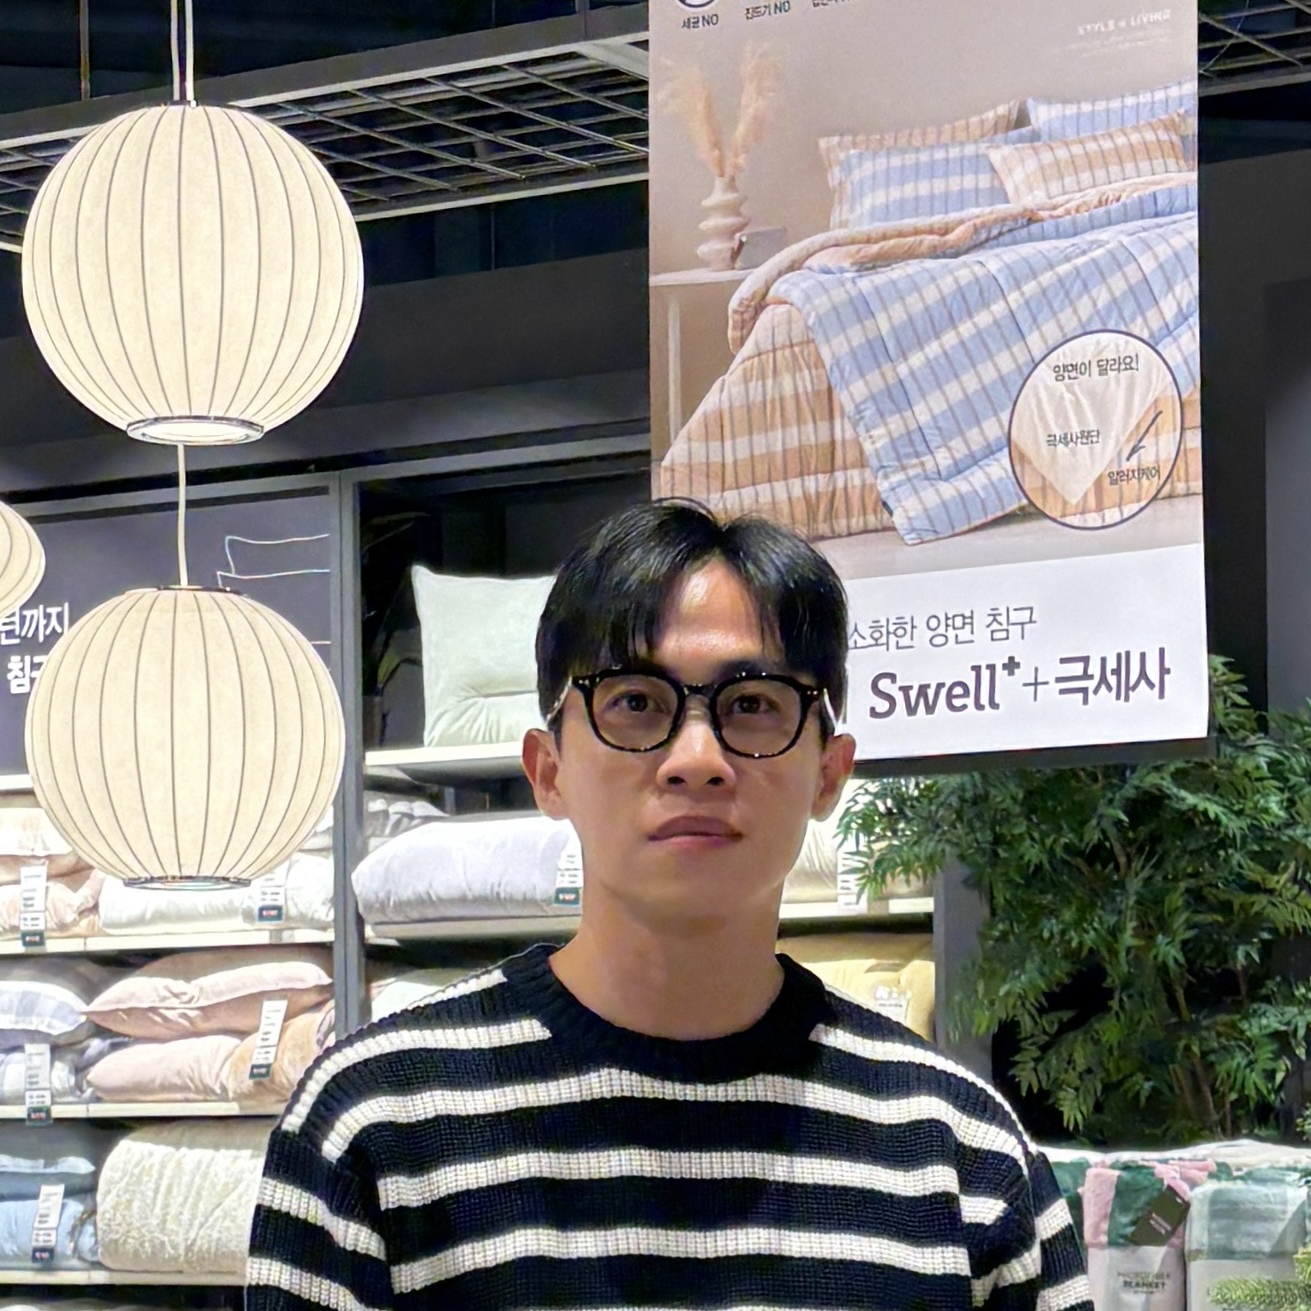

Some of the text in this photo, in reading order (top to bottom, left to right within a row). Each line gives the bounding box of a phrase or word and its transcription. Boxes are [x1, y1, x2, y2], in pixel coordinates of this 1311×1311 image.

[774, 0, 790, 15] NO
[702, 13, 719, 27] NO
[1053, 354, 1139, 382] 양면이 달라요!
[926, 609, 975, 648] 양면
[986, 606, 1037, 641] 침구
